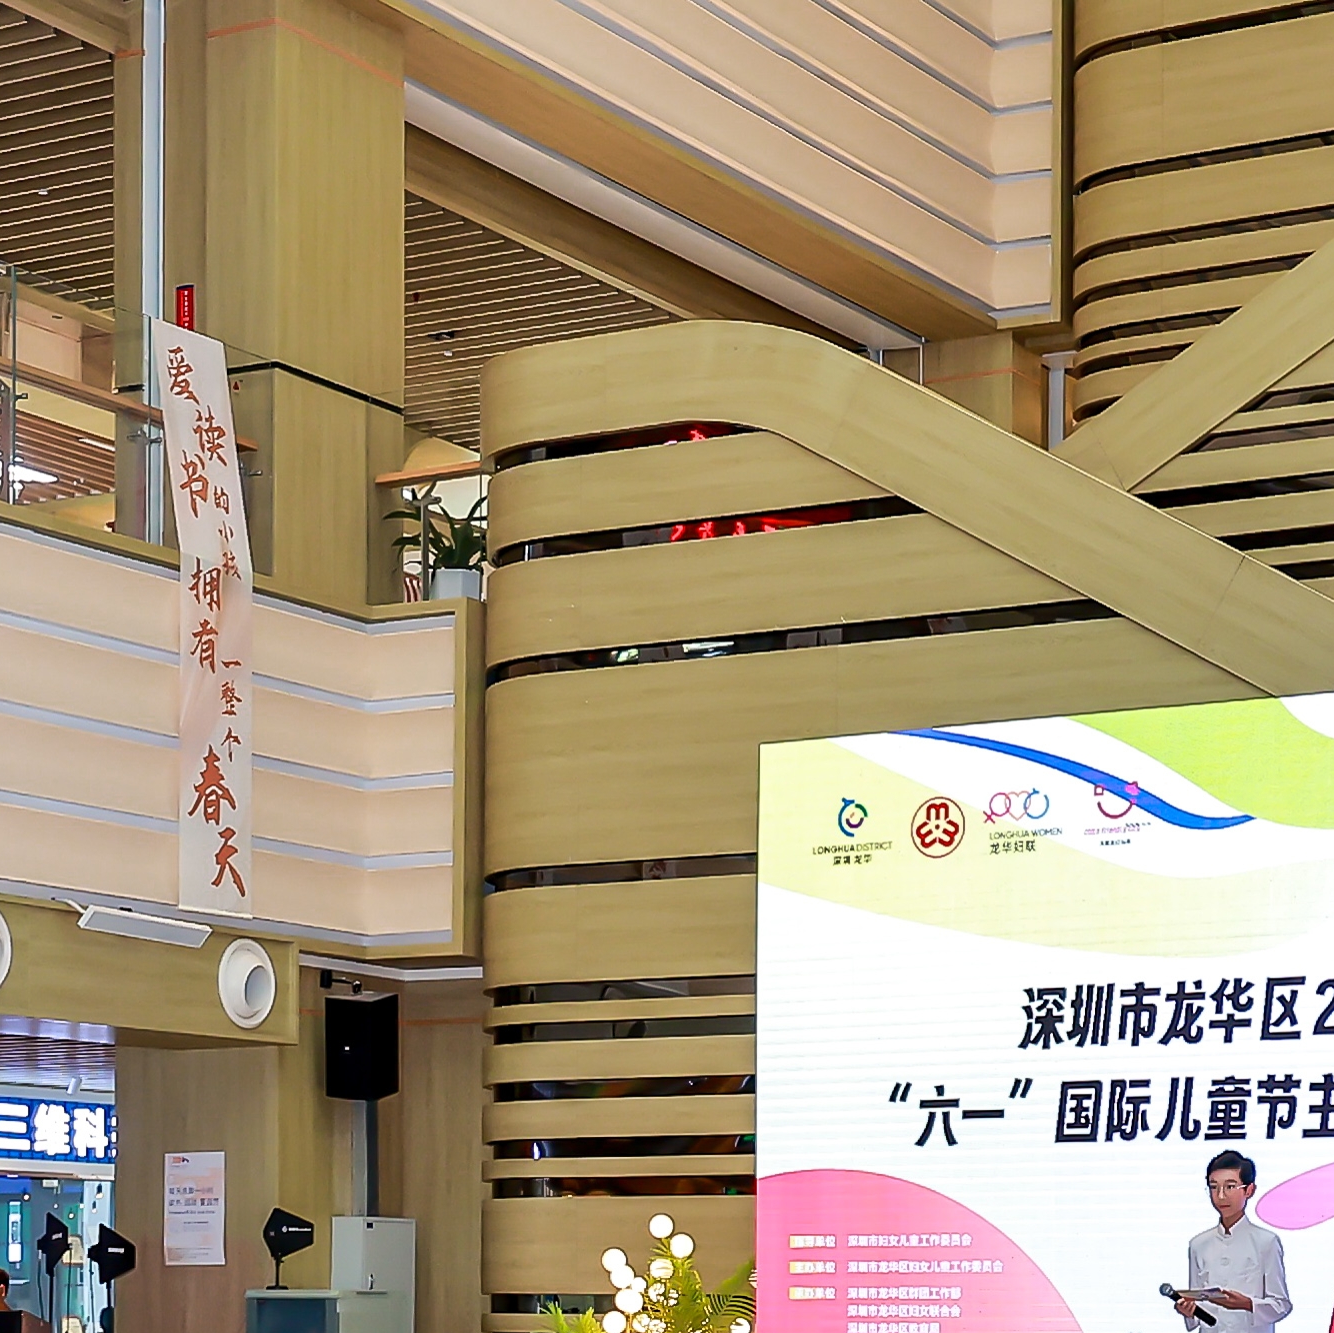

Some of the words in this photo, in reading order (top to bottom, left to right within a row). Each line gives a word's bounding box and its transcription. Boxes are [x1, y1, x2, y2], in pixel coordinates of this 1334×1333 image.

[989, 829, 1030, 840] LONGHUA
[1031, 827, 1063, 838] WOMEN
[990, 839, 1036, 855] 龙华妇联
